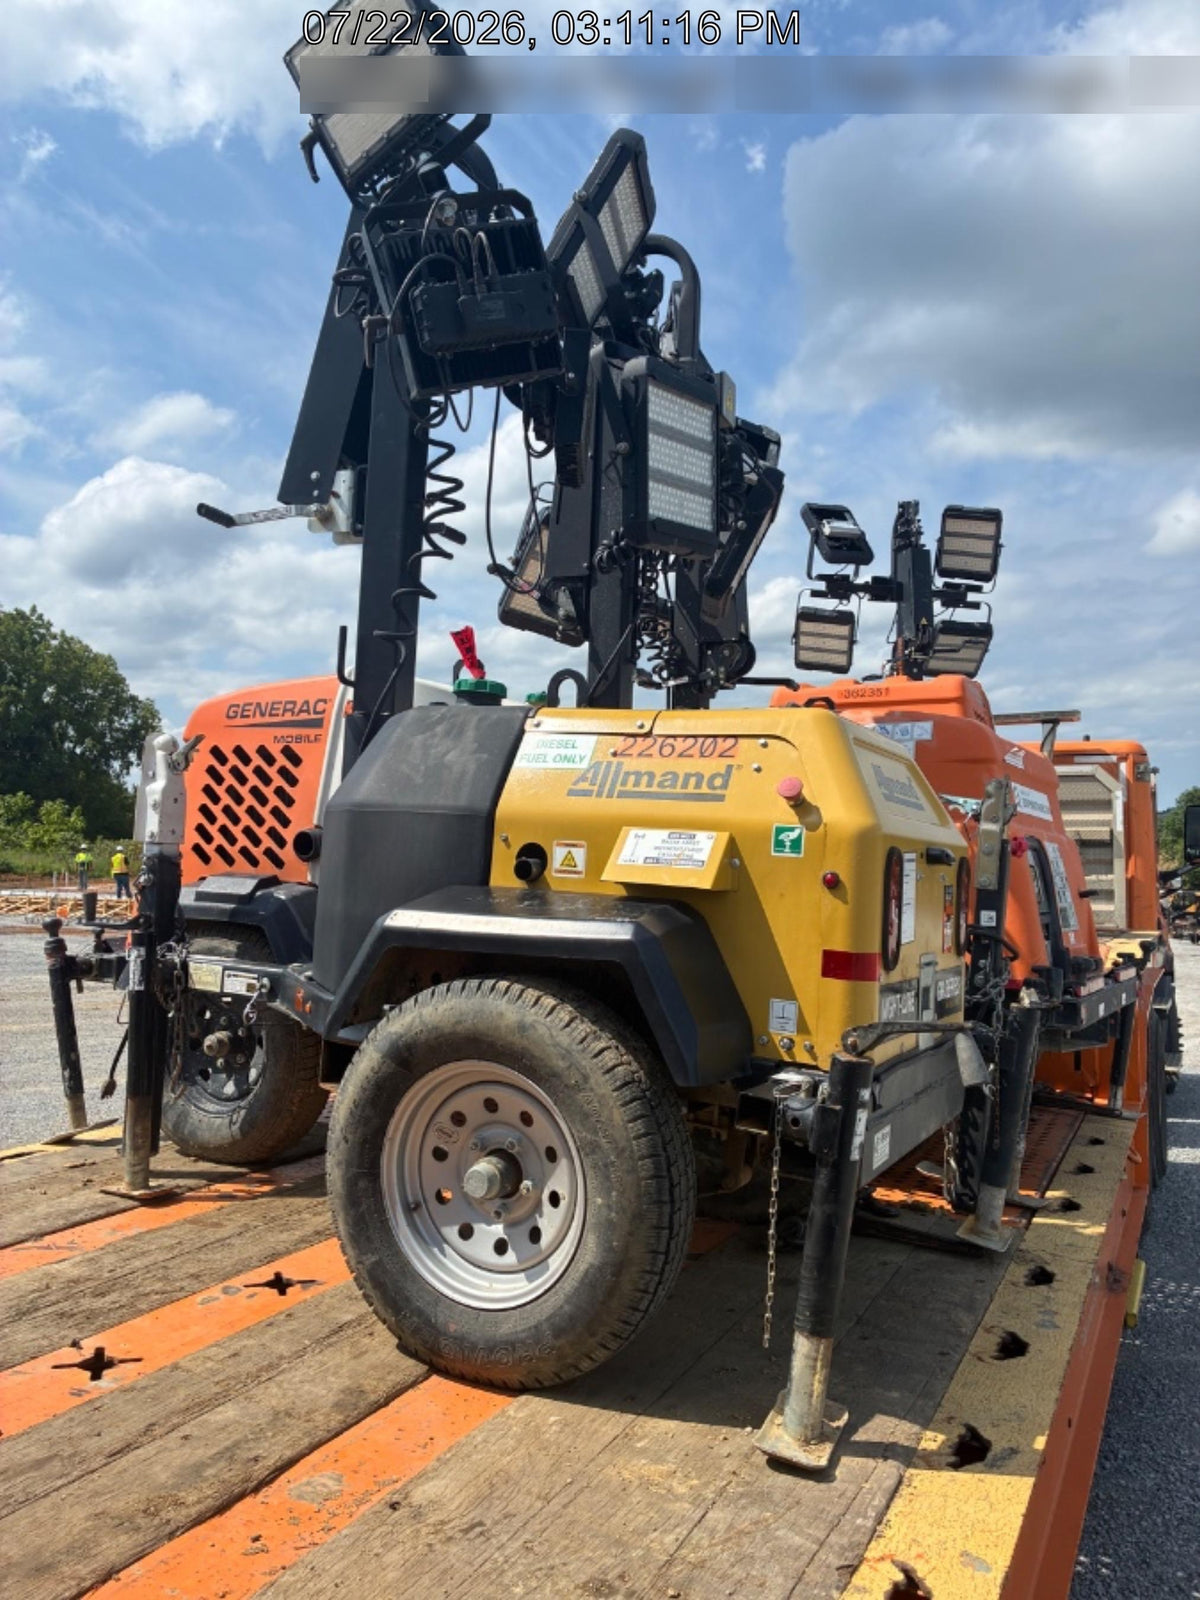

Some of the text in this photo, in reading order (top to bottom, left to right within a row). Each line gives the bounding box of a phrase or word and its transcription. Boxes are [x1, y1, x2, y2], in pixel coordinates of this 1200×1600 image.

[225, 698, 328, 720] GENERAC
[273, 733, 323, 744] MOBILE
[536, 738, 579, 750] DIESEL
[615, 736, 740, 758] 226202
[519, 752, 588, 765] FUEL ONLY
[571, 760, 735, 799] Allmand
